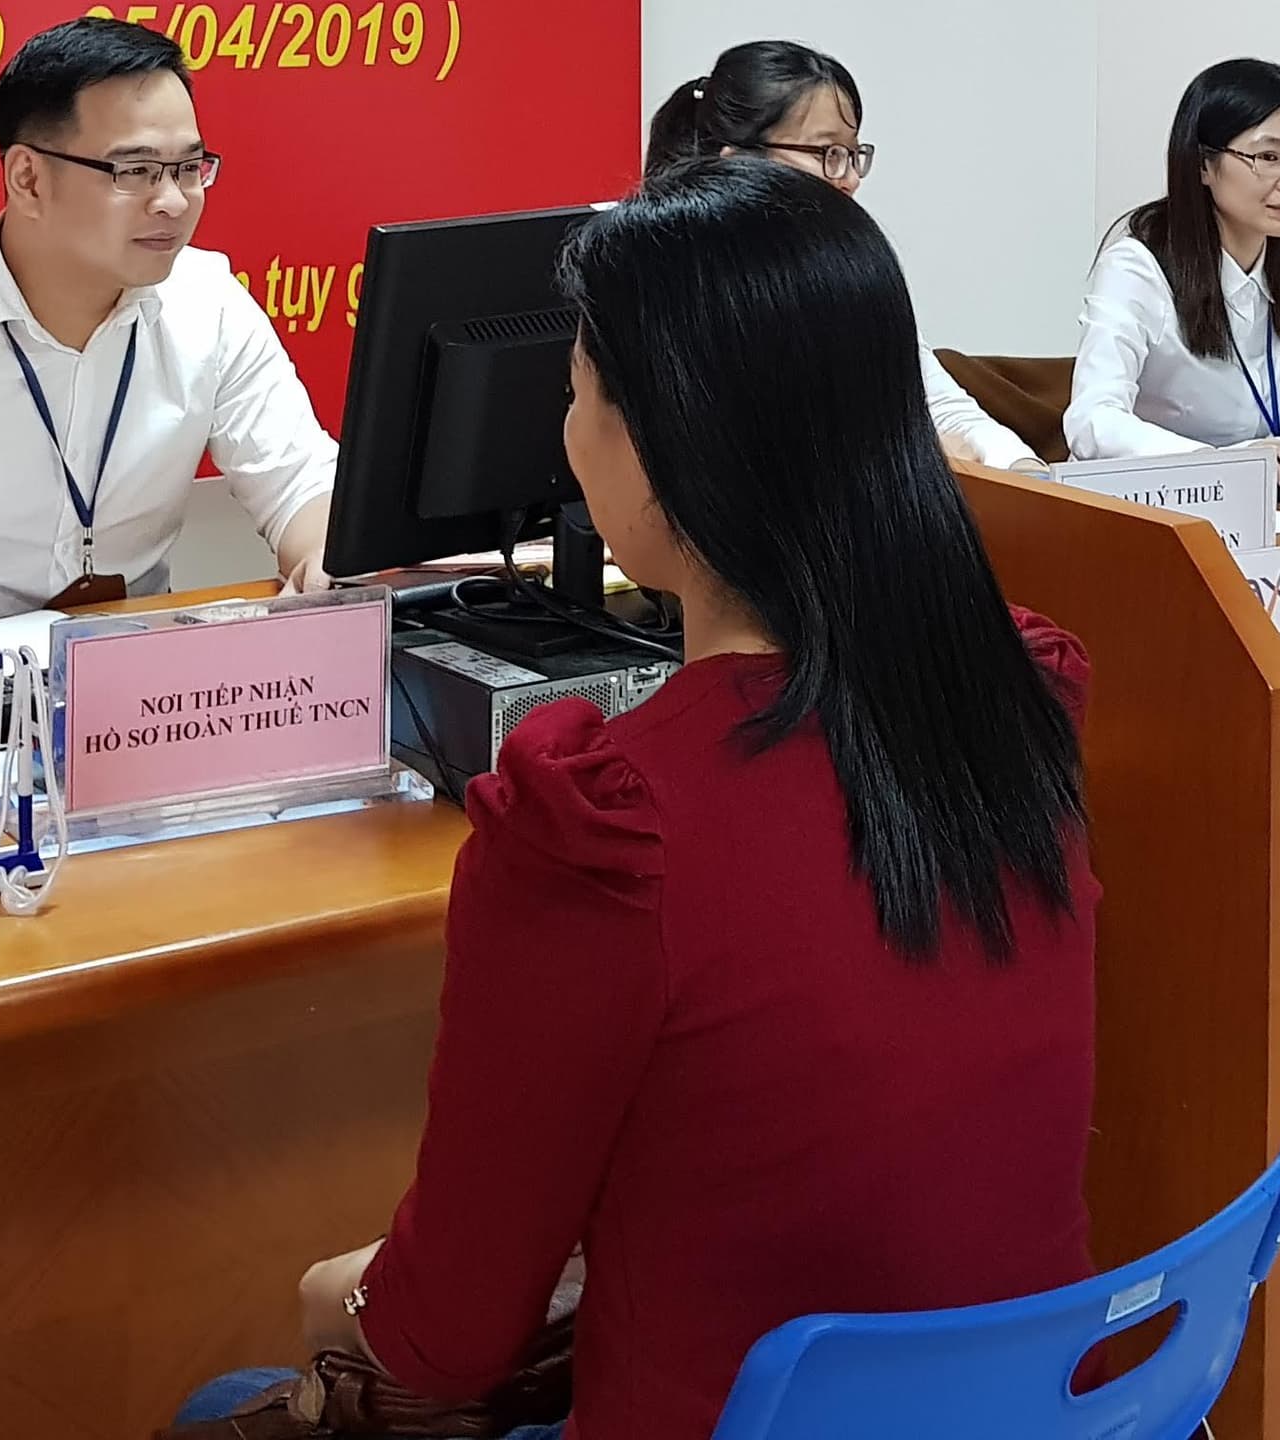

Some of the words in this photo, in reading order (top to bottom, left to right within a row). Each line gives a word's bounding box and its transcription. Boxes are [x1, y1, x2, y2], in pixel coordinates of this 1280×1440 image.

[84, 2, 425, 72] /04/2019
[265, 255, 336, 333] tụy
[127, 724, 160, 748] SƠ
[166, 714, 233, 743] HOÀN
[309, 696, 371, 723] TNCN
[140, 693, 183, 717] NƠI
[190, 682, 243, 710] TIẾP
[249, 675, 315, 702] NHẬN
